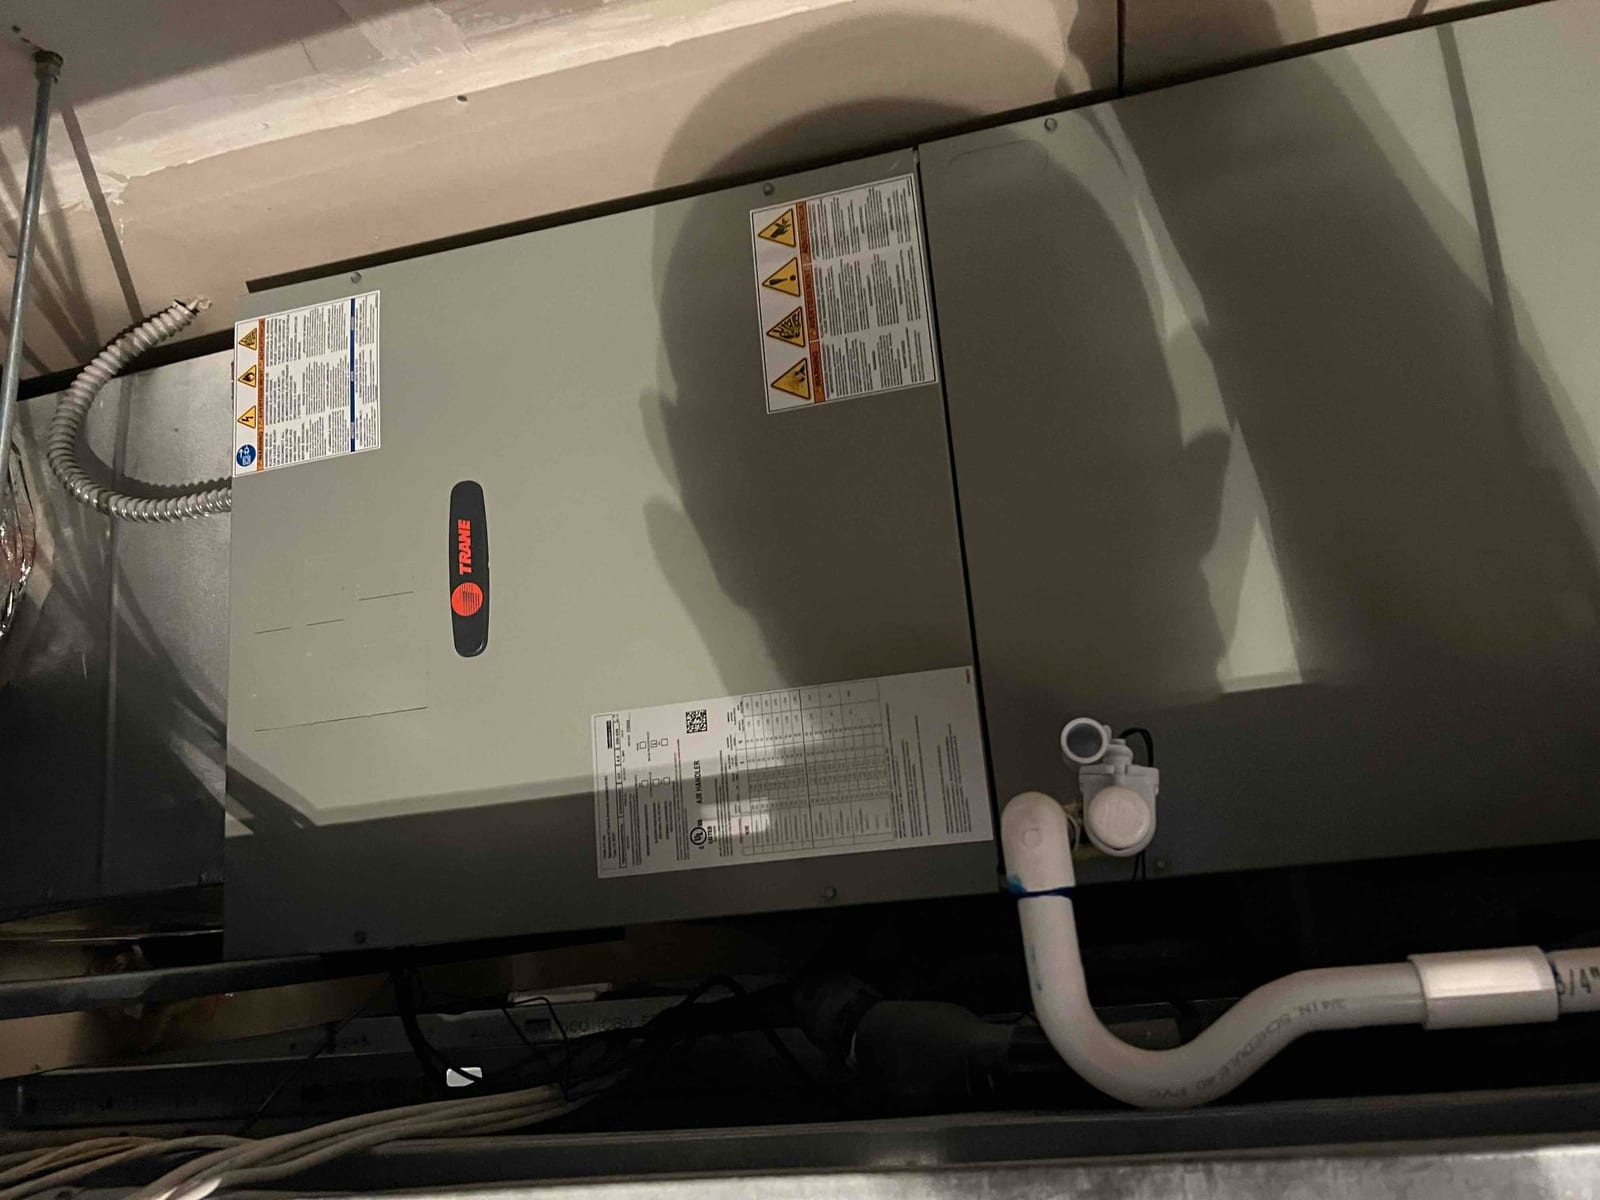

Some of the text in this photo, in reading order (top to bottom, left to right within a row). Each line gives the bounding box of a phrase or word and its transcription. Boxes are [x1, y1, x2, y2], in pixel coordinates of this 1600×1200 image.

[457, 519, 472, 575] TRANE
[693, 760, 703, 804] AIR HANDLER
[693, 831, 703, 841] UL
